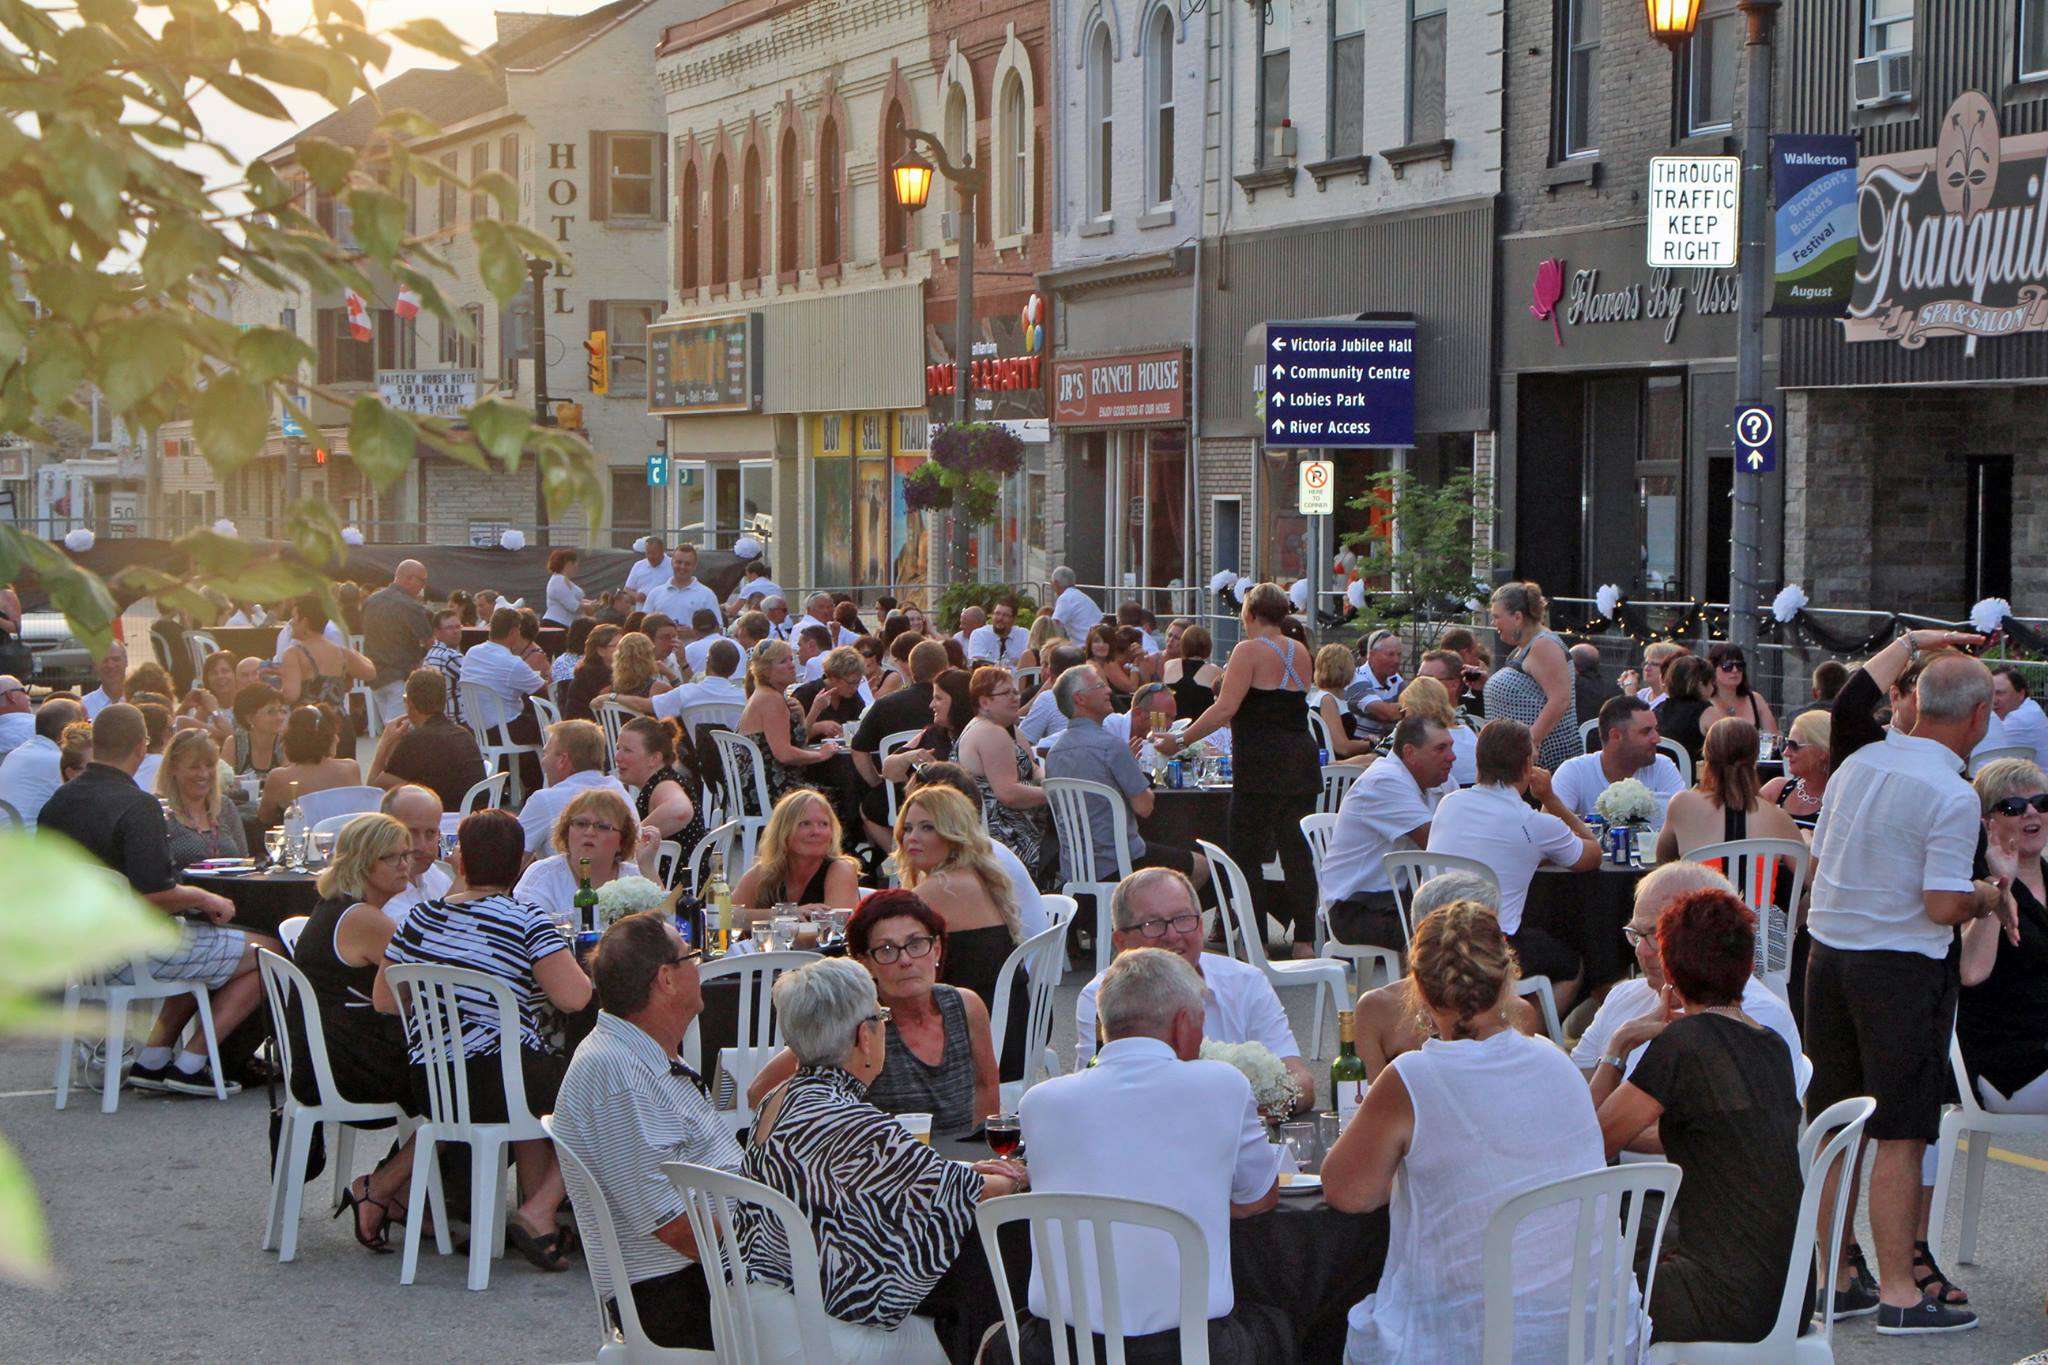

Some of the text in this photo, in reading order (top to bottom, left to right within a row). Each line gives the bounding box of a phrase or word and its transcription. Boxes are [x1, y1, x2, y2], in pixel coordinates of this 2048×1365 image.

[1784, 153, 1847, 165] Walkerton
[1658, 163, 1733, 183] THROUGH
[1654, 190, 1734, 209] TRAFFIC
[1788, 173, 1848, 217] Brockton's
[1669, 216, 1718, 234] KEEP
[1790, 196, 1834, 236] Buskers
[548, 143, 577, 314] HOTEL
[1664, 241, 1720, 260] RIGHT
[1792, 222, 1836, 263] Festival
[1790, 285, 1833, 300] August
[1567, 269, 1641, 325] Flowers
[1647, 267, 1685, 344] By
[1920, 304, 2027, 334] SPA & SALON
[1291, 338, 1412, 353] Victoria Jubilee Hall
[422, 374, 447, 383] HOUSE
[451, 373, 476, 383] HOTEL
[1060, 360, 1179, 401] JR'S RANCH HOUSE
[1290, 366, 1410, 382] Community Centre
[1290, 393, 1365, 406] Lobies Park
[1113, 406, 1125, 417] GOOD
[1126, 405, 1138, 416] FOOD
[1154, 402, 1170, 414] HOUSE
[823, 415, 840, 450] BUY
[863, 415, 880, 450] SELL
[1290, 420, 1371, 434] River Access
[114, 507, 134, 520] 50
